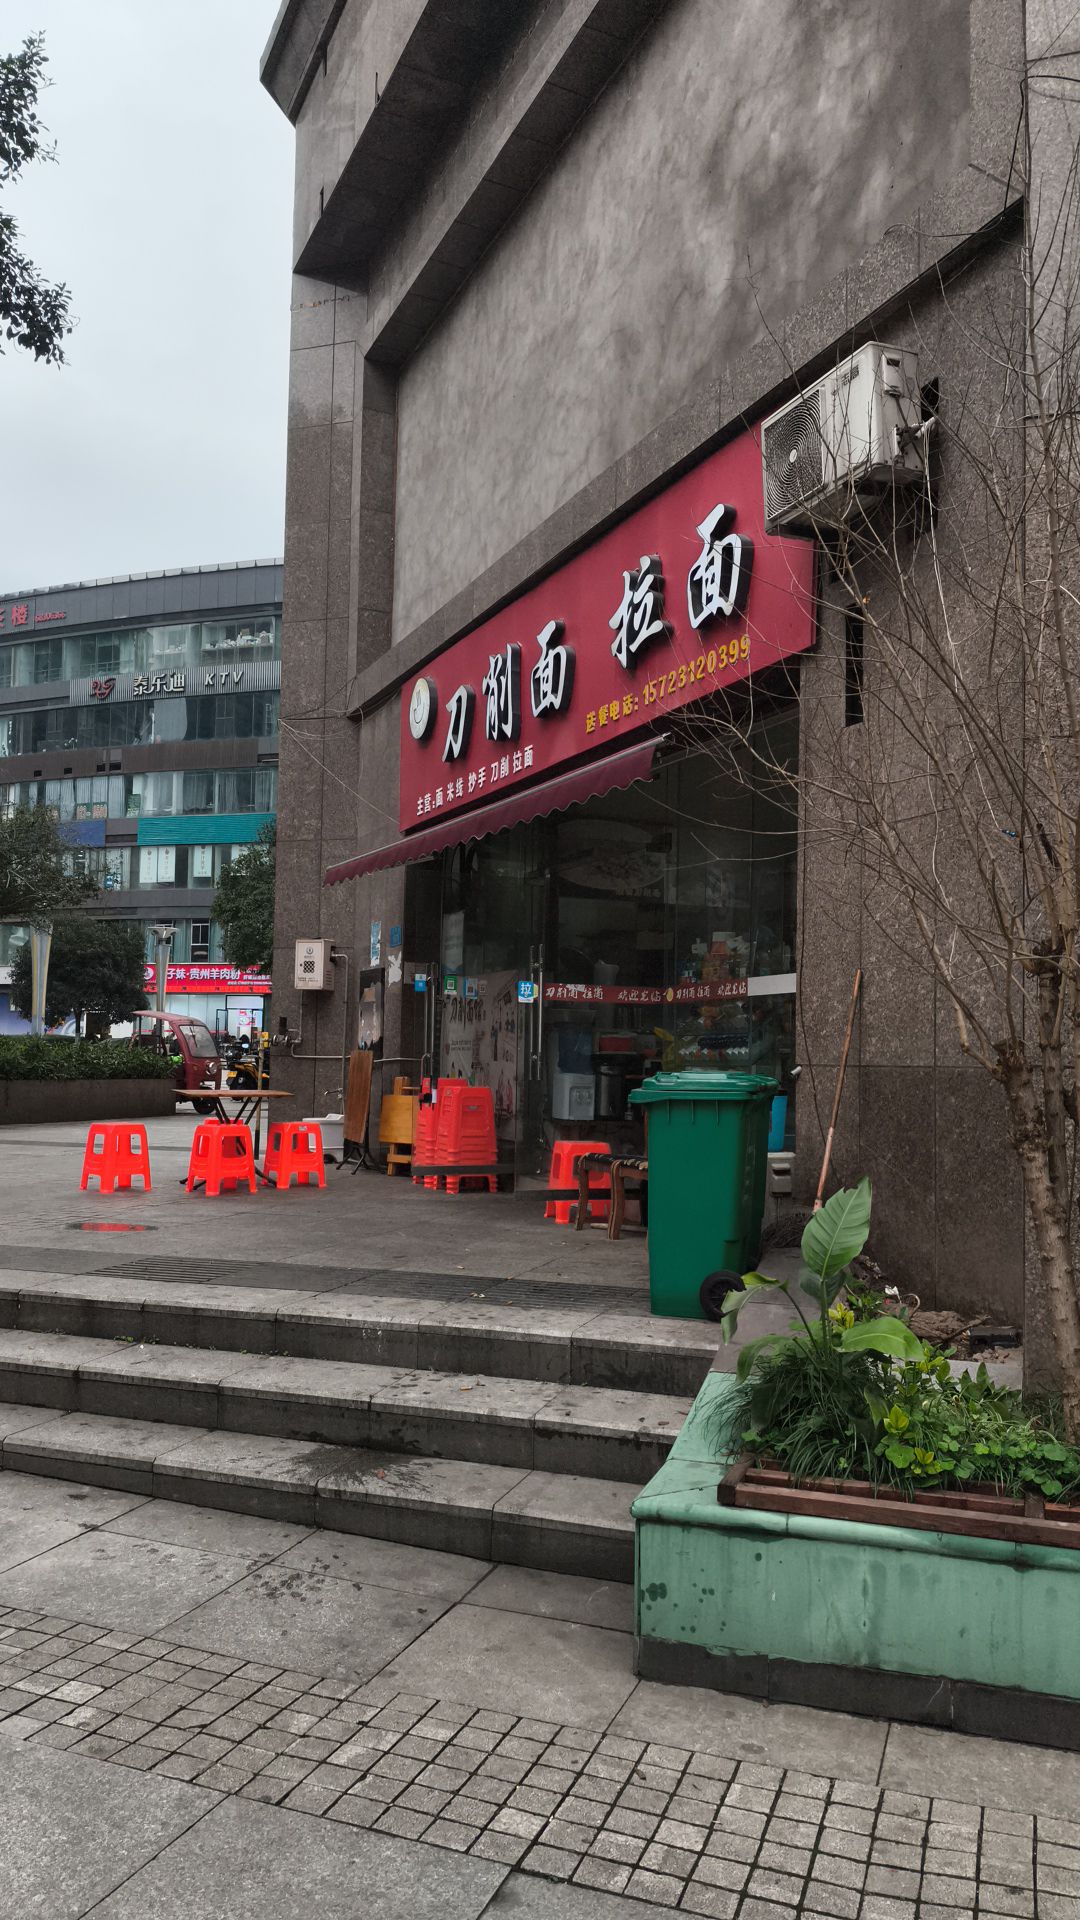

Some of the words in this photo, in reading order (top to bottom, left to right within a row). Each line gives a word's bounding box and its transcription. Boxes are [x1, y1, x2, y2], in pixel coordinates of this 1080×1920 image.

[442, 619, 570, 763] 刀削面
[608, 503, 746, 669] 拉面
[134, 672, 185, 696] 泰乐迪
[205, 671, 243, 686] KTV
[642, 634, 751, 705] 15723120399
[490, 755, 509, 783] 刀削
[512, 744, 534, 774] 拉面
